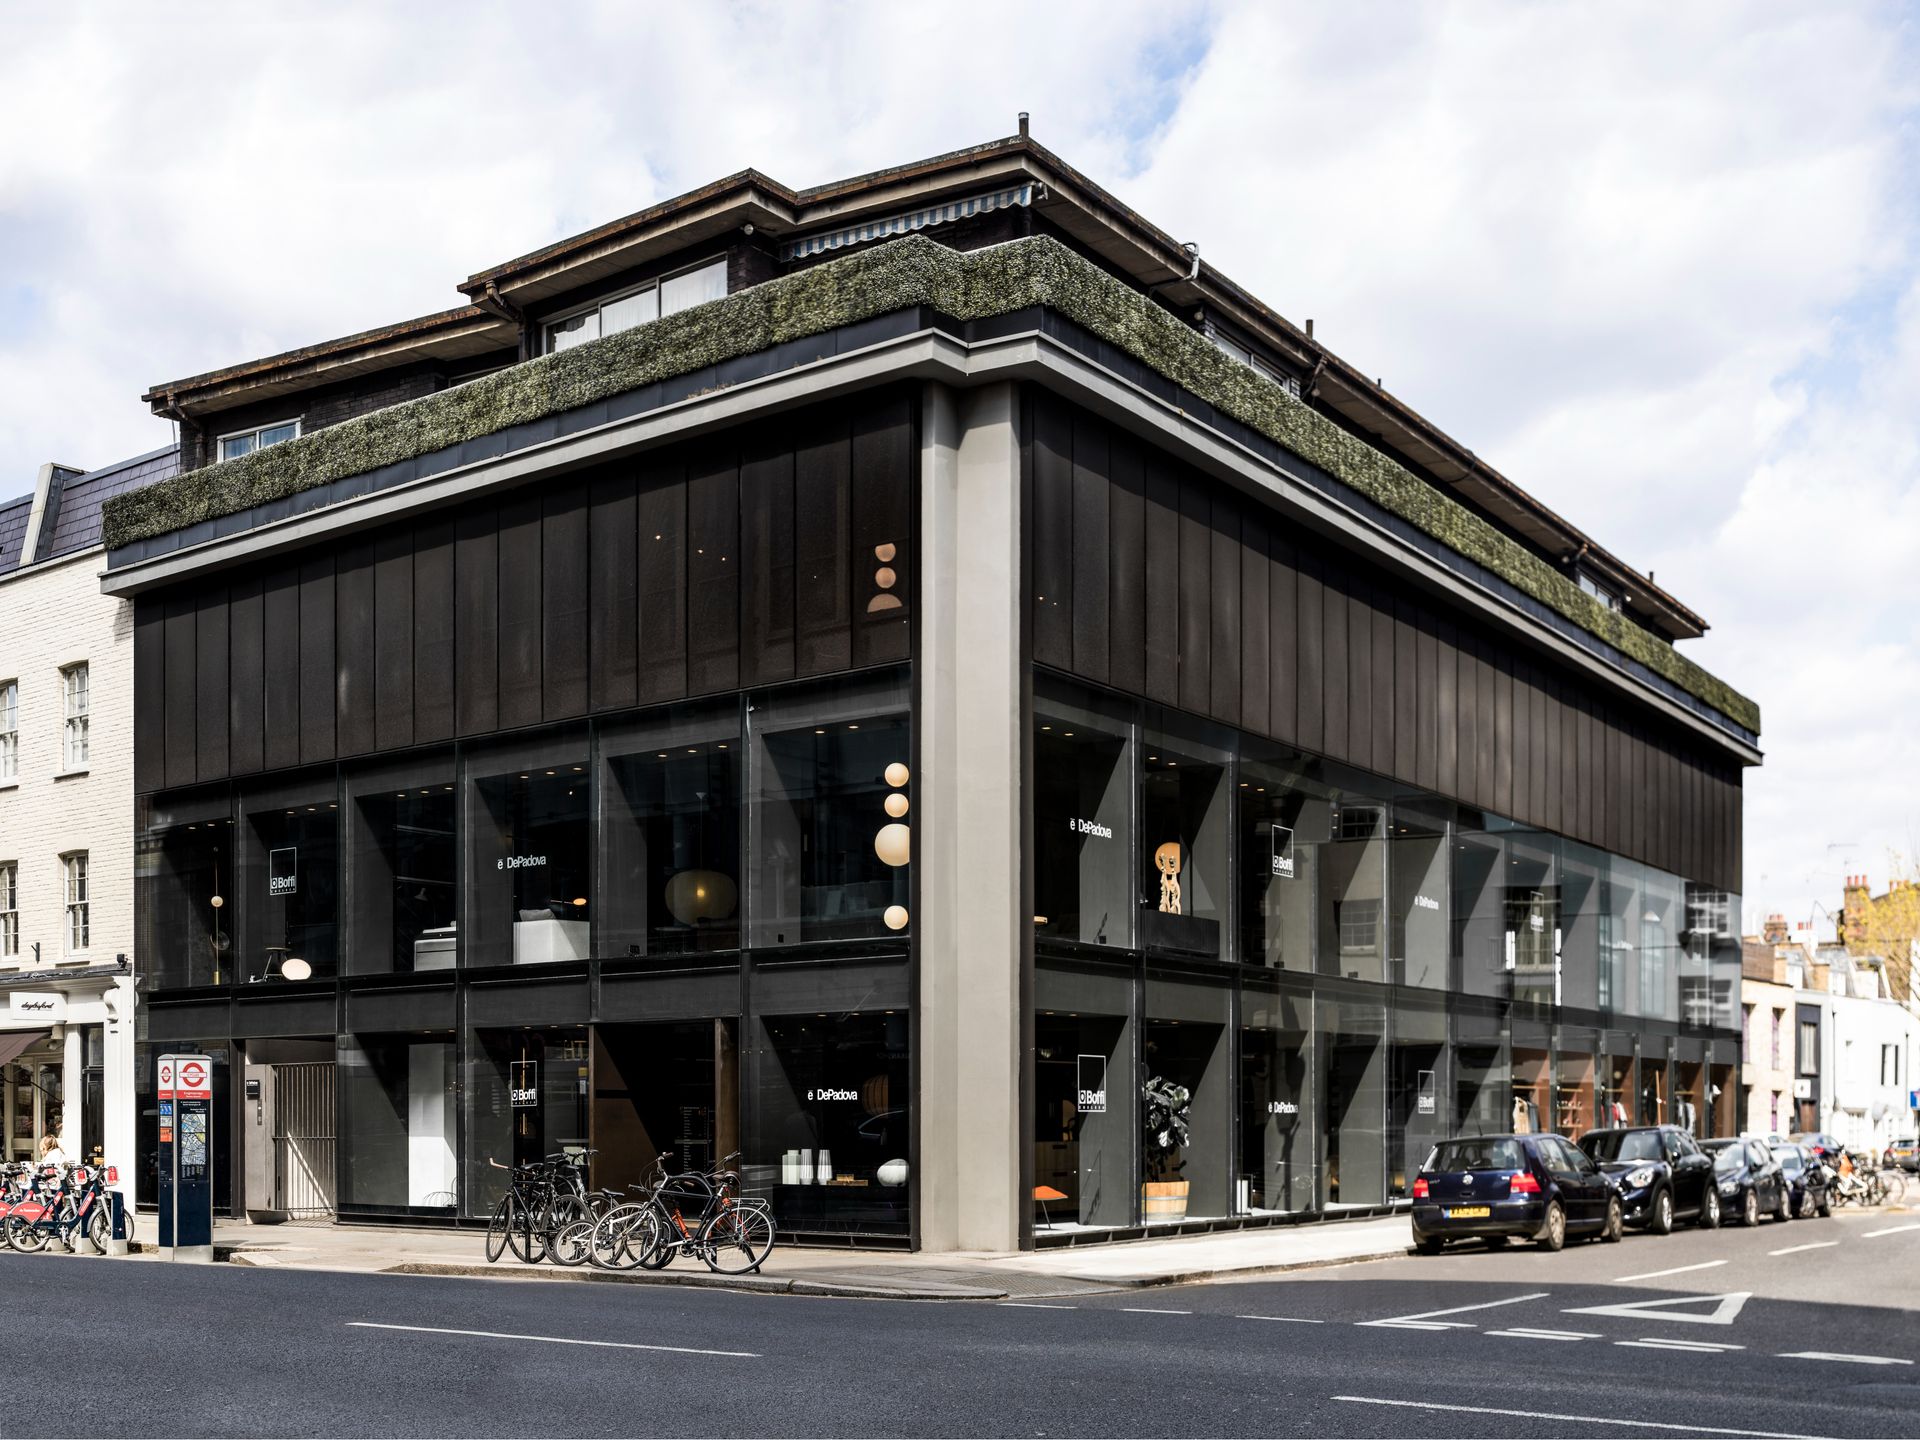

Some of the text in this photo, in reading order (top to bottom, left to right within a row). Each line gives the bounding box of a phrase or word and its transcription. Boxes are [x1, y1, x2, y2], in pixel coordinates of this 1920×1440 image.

[1078, 818, 1112, 838] DePadova
[507, 854, 546, 869] DePadova
[518, 1088, 536, 1100] Boffi
[817, 1088, 857, 1100] DePadova
[1086, 1090, 1105, 1104] Boffi
